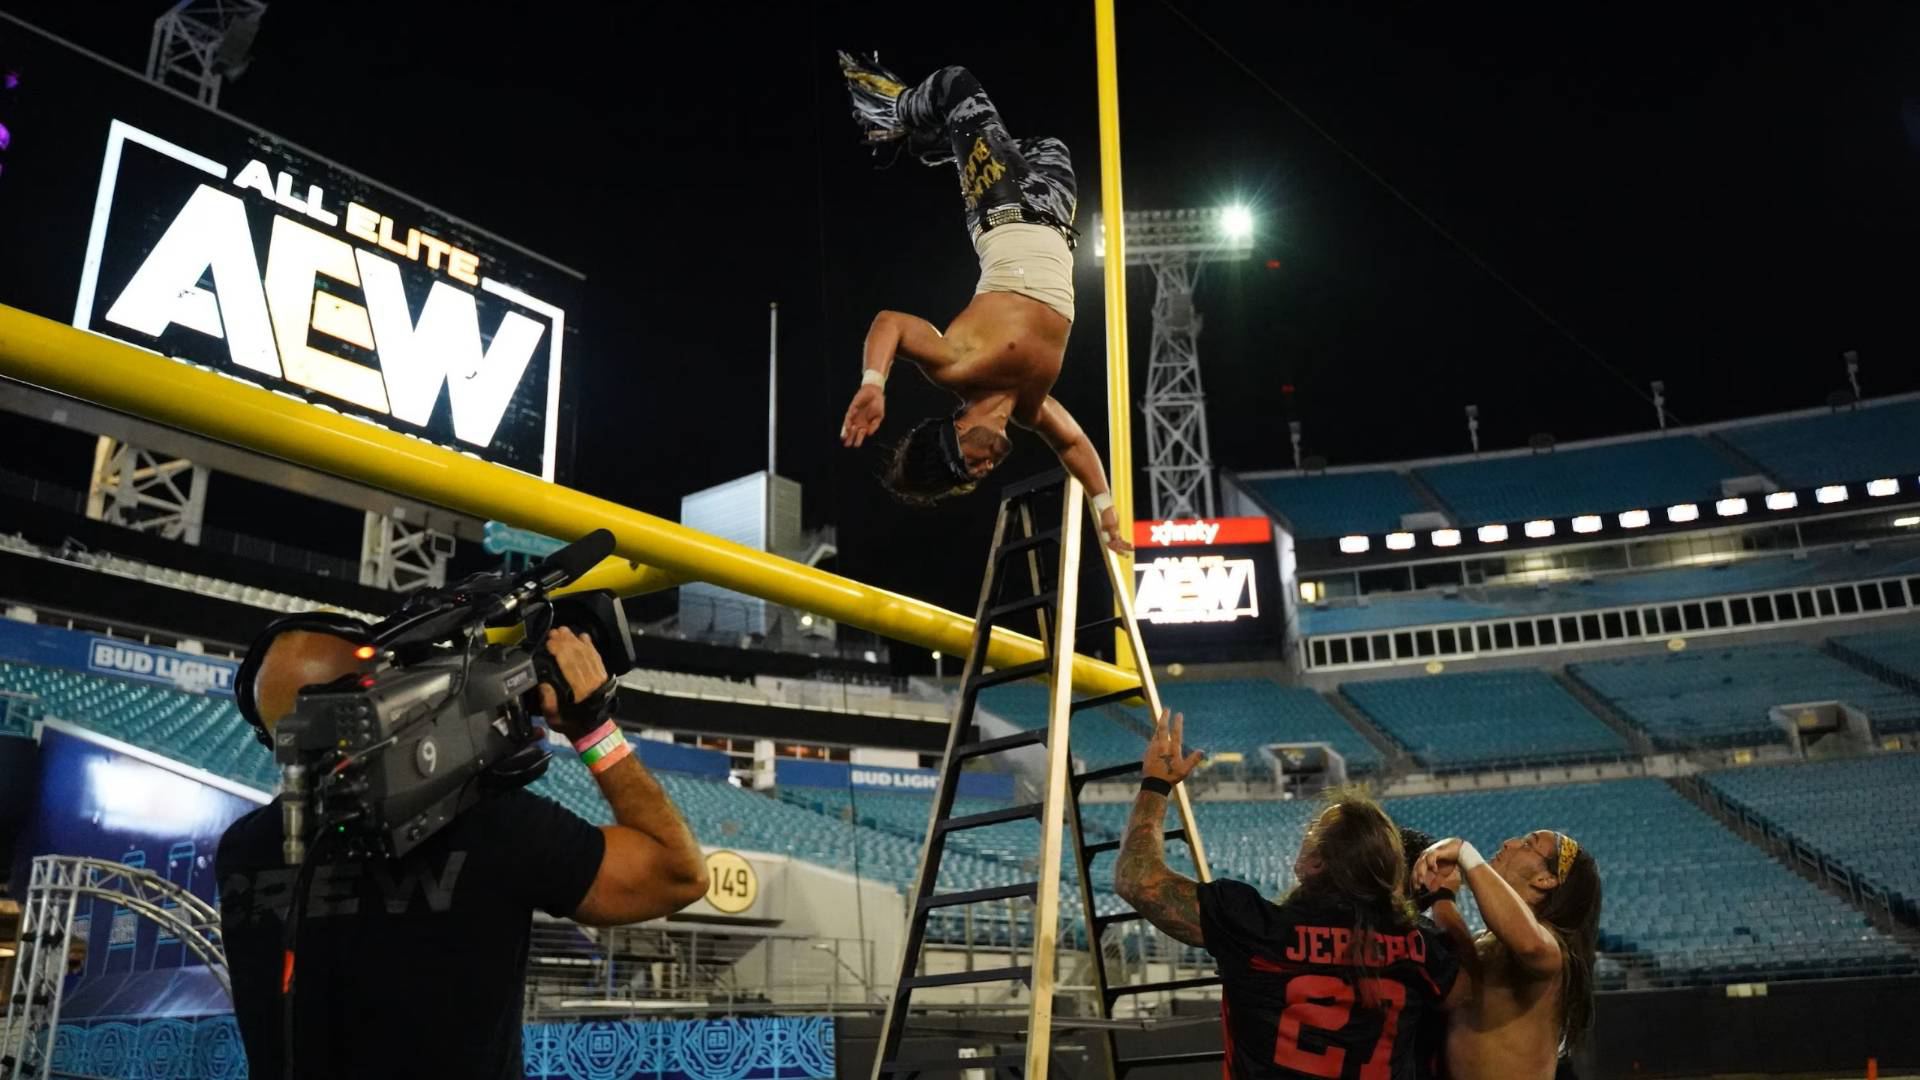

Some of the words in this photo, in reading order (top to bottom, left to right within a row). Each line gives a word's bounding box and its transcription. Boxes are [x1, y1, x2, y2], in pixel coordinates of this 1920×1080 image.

[234, 159, 338, 227] ALL
[346, 201, 480, 286] ELITE
[105, 182, 545, 448] AEW
[1150, 520, 1219, 546] xfinity
[1135, 565, 1249, 614] AEW
[94, 644, 153, 673] BUD
[423, 741, 437, 773] 9
[851, 769, 892, 787] BUD
[222, 850, 467, 926] CREW
[713, 866, 748, 898] 149
[1285, 924, 1427, 967] JERICHO
[1272, 973, 1407, 1080] 27
